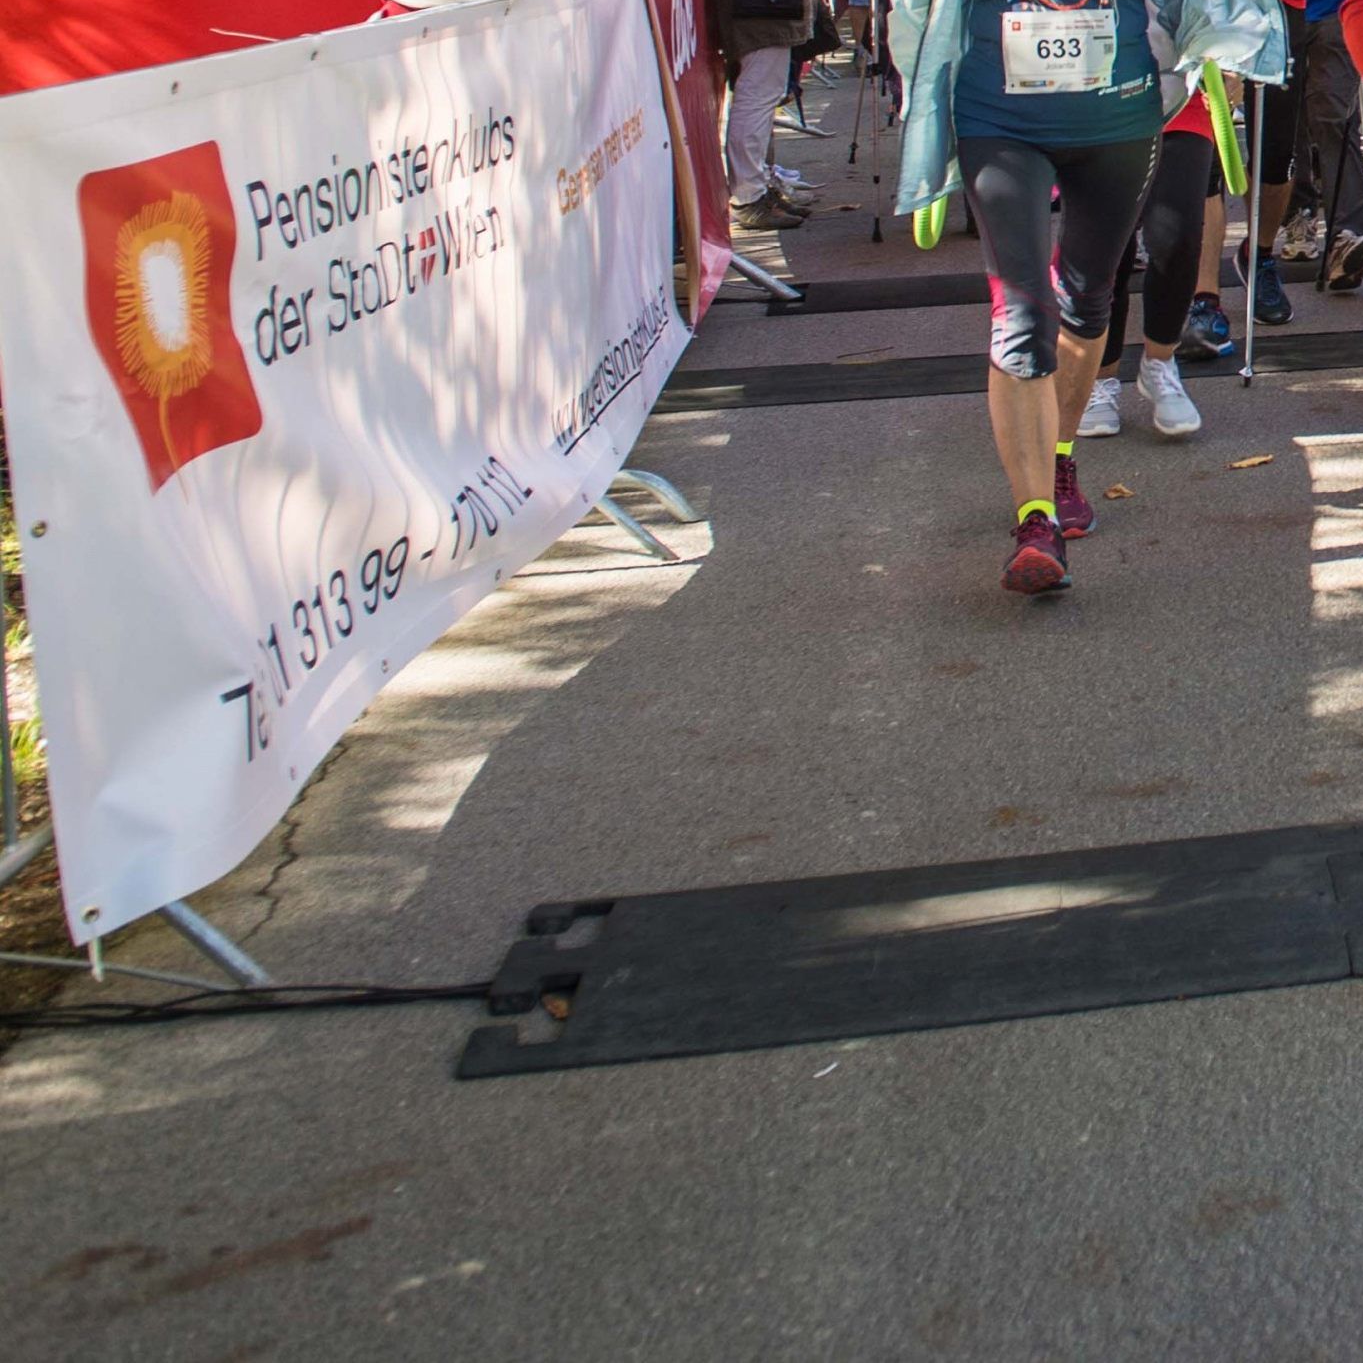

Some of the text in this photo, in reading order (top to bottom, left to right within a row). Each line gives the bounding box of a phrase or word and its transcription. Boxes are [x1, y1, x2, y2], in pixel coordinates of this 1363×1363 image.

[1037, 38, 1082, 59] 633
[246, 106, 515, 261] Pensionistenklubs
[255, 196, 505, 366] der StaDt Wien
[293, 570, 353, 670] 313
[361, 536, 409, 615] 99
[451, 485, 498, 560] 170
[476, 456, 534, 516] 112
